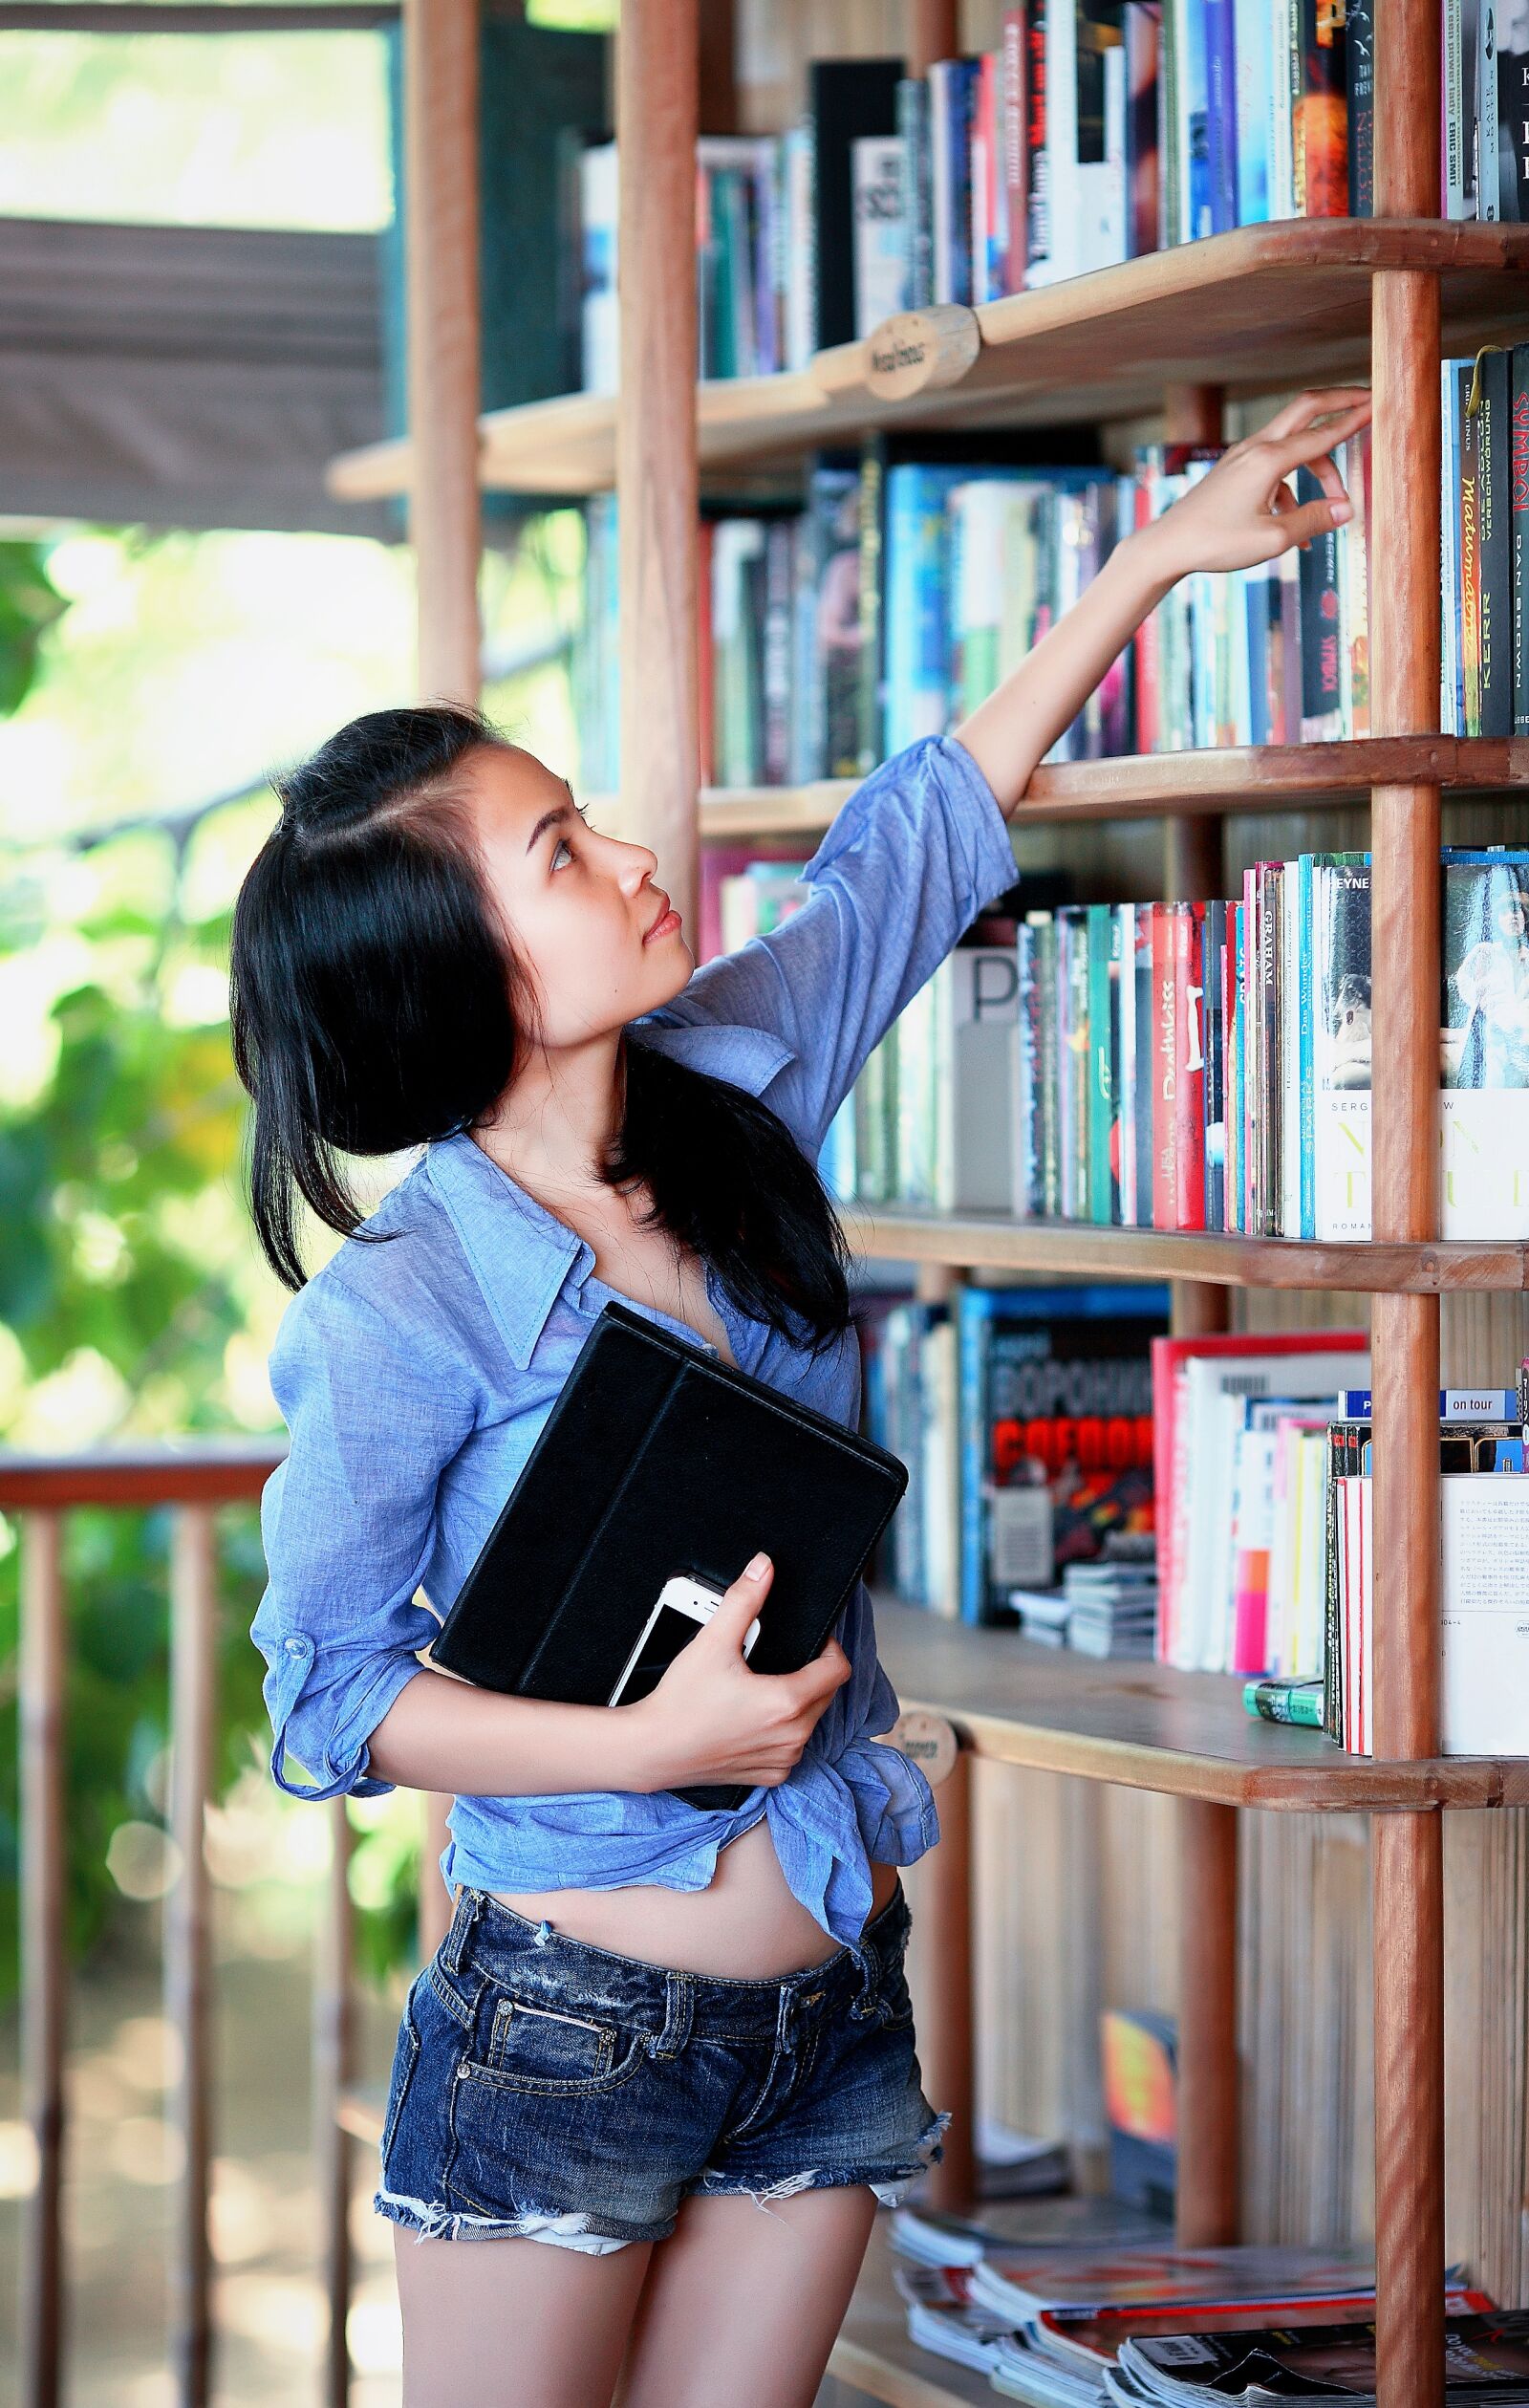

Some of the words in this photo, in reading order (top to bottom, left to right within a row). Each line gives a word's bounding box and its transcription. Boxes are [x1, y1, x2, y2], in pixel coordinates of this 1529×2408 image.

[1447, 42, 1455, 83] power
[1447, 87, 1455, 116] lady
[1449, 155, 1457, 187] SMIT
[1482, 592, 1491, 689] KERR
[1264, 910, 1273, 986] GRAHAM
[1305, 1065, 1315, 1155] SPARKS
[1363, 1399, 1372, 1411] P
[1453, 1401, 1467, 1410] on
[1470, 1399, 1492, 1410] tour
